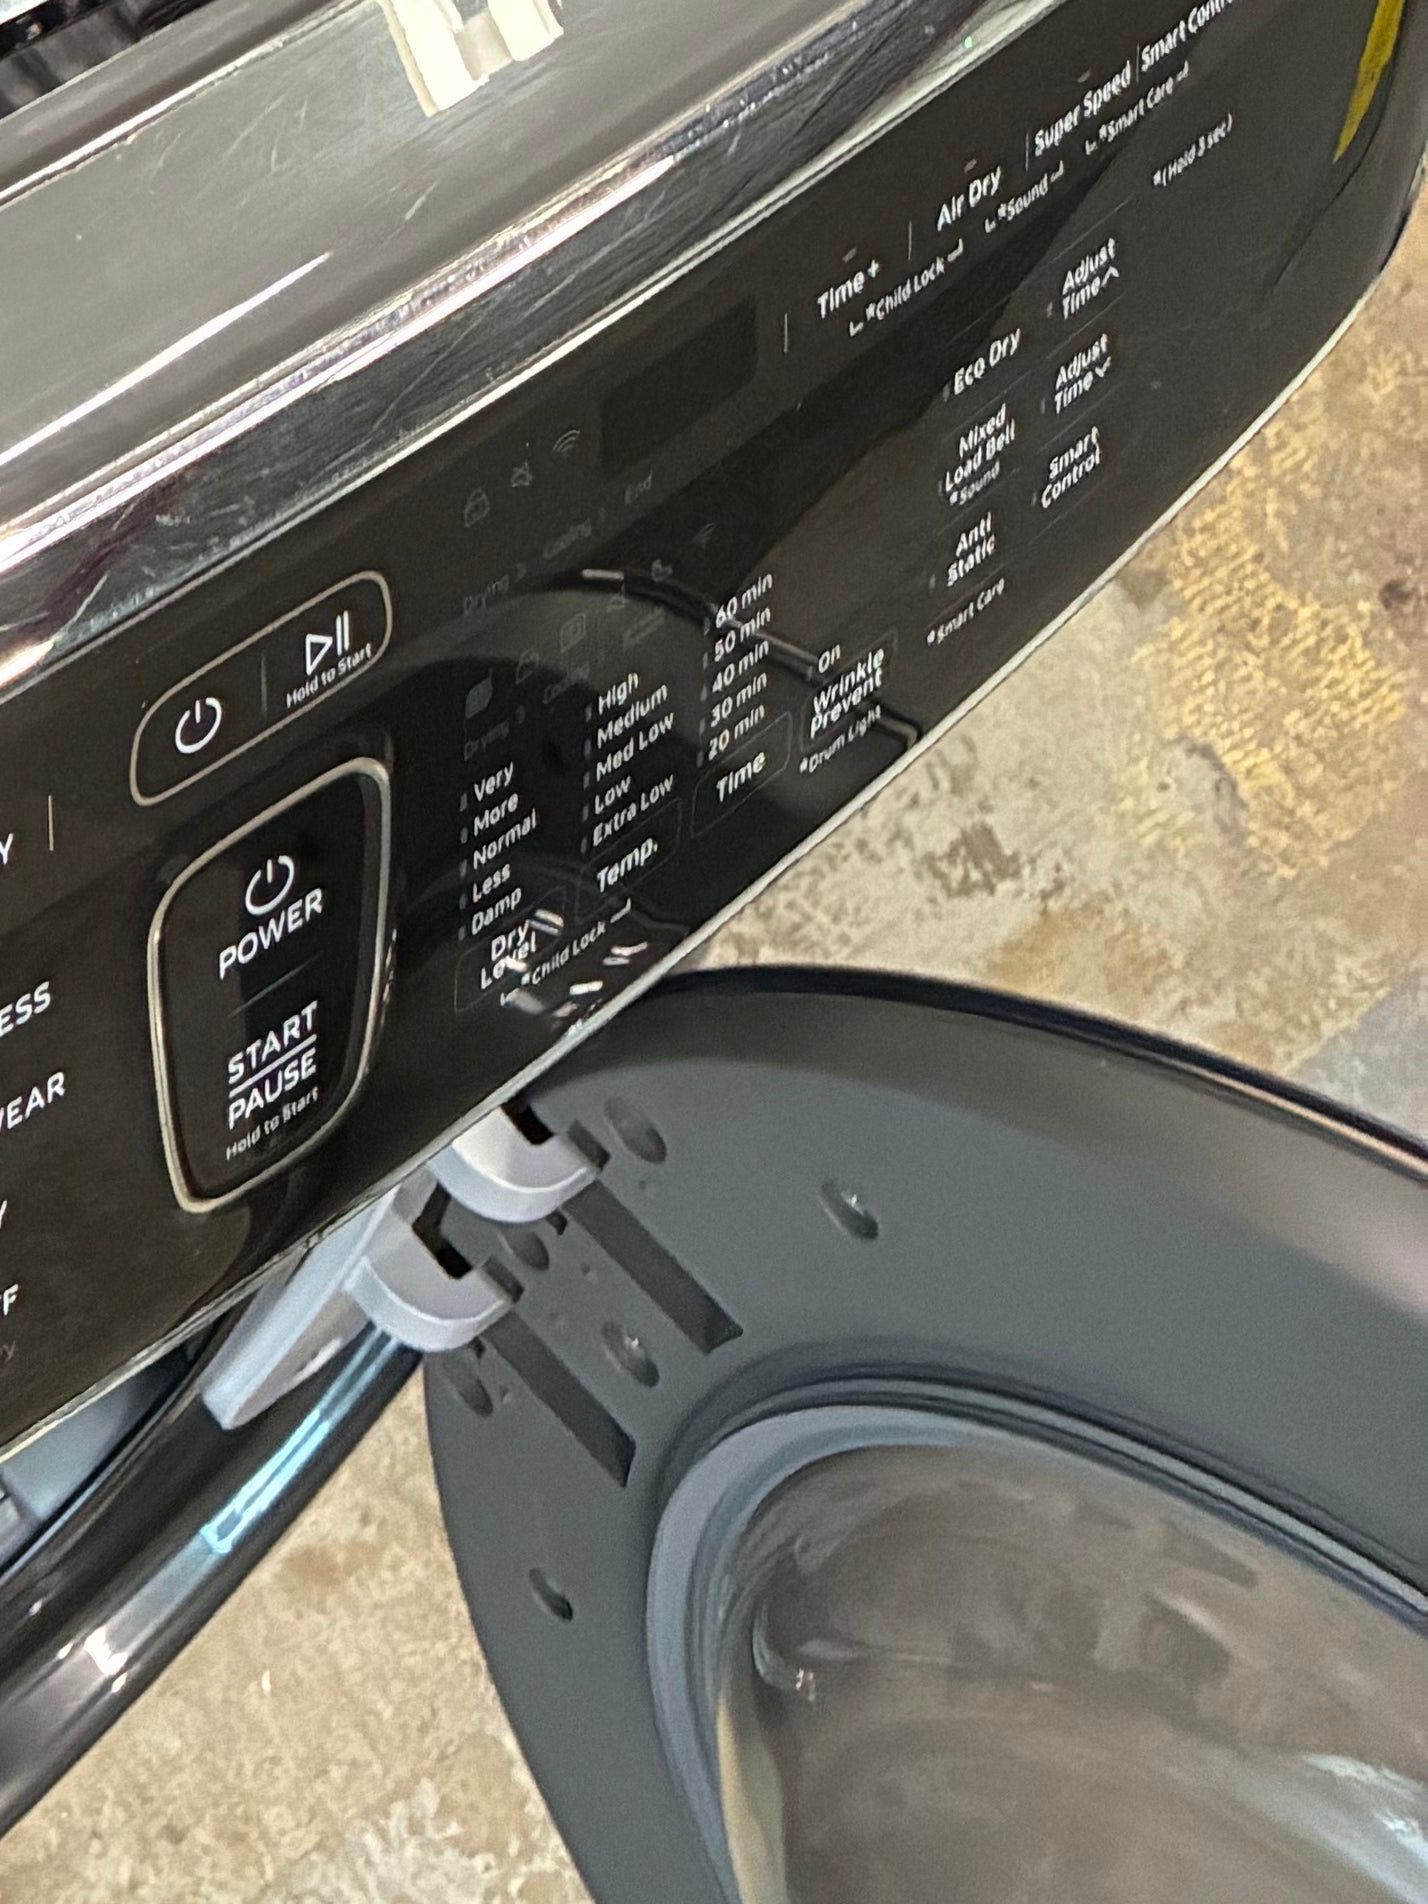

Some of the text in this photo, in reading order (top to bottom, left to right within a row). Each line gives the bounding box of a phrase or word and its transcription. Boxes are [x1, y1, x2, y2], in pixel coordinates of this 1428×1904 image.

[1141, 20, 1187, 73] Smart
[1033, 59, 1132, 157] Super Speed
[1146, 75, 1174, 110] Care
[937, 165, 1002, 232] Air Dry
[912, 255, 945, 293] Lock
[1062, 237, 1117, 295] Adjust
[816, 271, 866, 320] Time
[1062, 276, 1101, 320] Time
[953, 327, 1022, 396] Eco Dry
[1055, 332, 1109, 391] Adjust
[1053, 370, 1094, 415] Time
[959, 402, 1007, 458] Mixed
[1048, 425, 1100, 480] Smart
[945, 447, 983, 492] Load
[1041, 442, 1101, 509] Control
[946, 534, 996, 587] Static
[955, 511, 993, 557] Anti
[715, 572, 774, 629] 60 min
[977, 576, 1006, 611] Care
[713, 607, 772, 663] 50 min
[816, 643, 842, 674] On
[285, 642, 373, 709] Hold to Start
[711, 639, 770, 693] 40 min
[812, 646, 886, 715] Wrinkle
[597, 672, 639, 716] High
[597, 683, 668, 749] Medium
[710, 672, 768, 728] 30 min
[810, 670, 883, 740] Prevent
[596, 711, 674, 782] Med Low
[708, 704, 766, 761] 20 min
[847, 703, 882, 746] Light
[473, 761, 514, 803] Very
[594, 775, 632, 815] Low
[716, 751, 767, 803] Time
[473, 792, 519, 837] More
[592, 773, 674, 848] Extra Low
[472, 807, 537, 871] Normal
[597, 836, 659, 893] Temp.
[472, 863, 511, 904] Less
[218, 887, 324, 981] POWER
[471, 887, 523, 936] Damp
[571, 920, 607, 957] Lock
[490, 919, 531, 962] Dry
[227, 999, 319, 1085] START
[227, 1046, 318, 1131] PAUSE
[225, 1085, 319, 1162] Hold to Start
